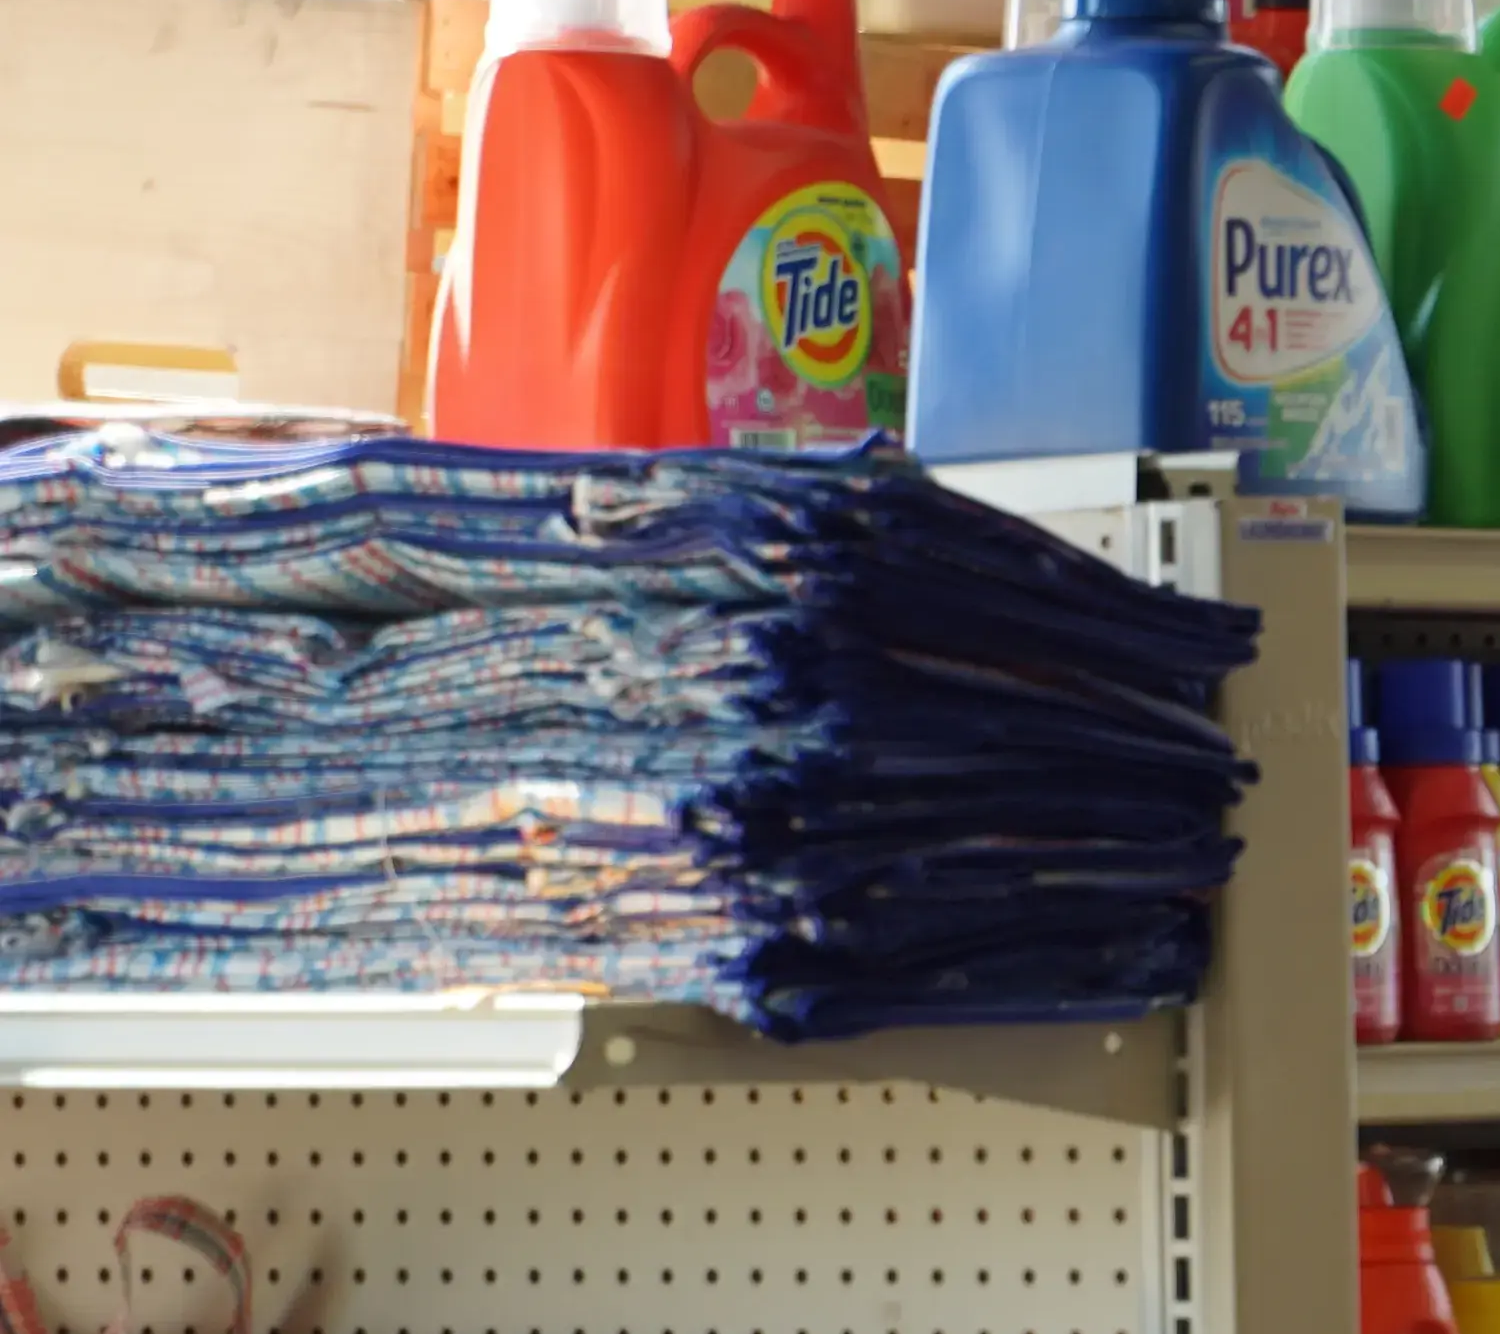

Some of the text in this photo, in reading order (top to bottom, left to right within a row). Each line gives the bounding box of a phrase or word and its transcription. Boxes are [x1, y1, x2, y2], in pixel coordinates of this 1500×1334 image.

[776, 257, 859, 349] Tide
[1225, 218, 1354, 303] Purex
[1437, 885, 1484, 936] Tide
